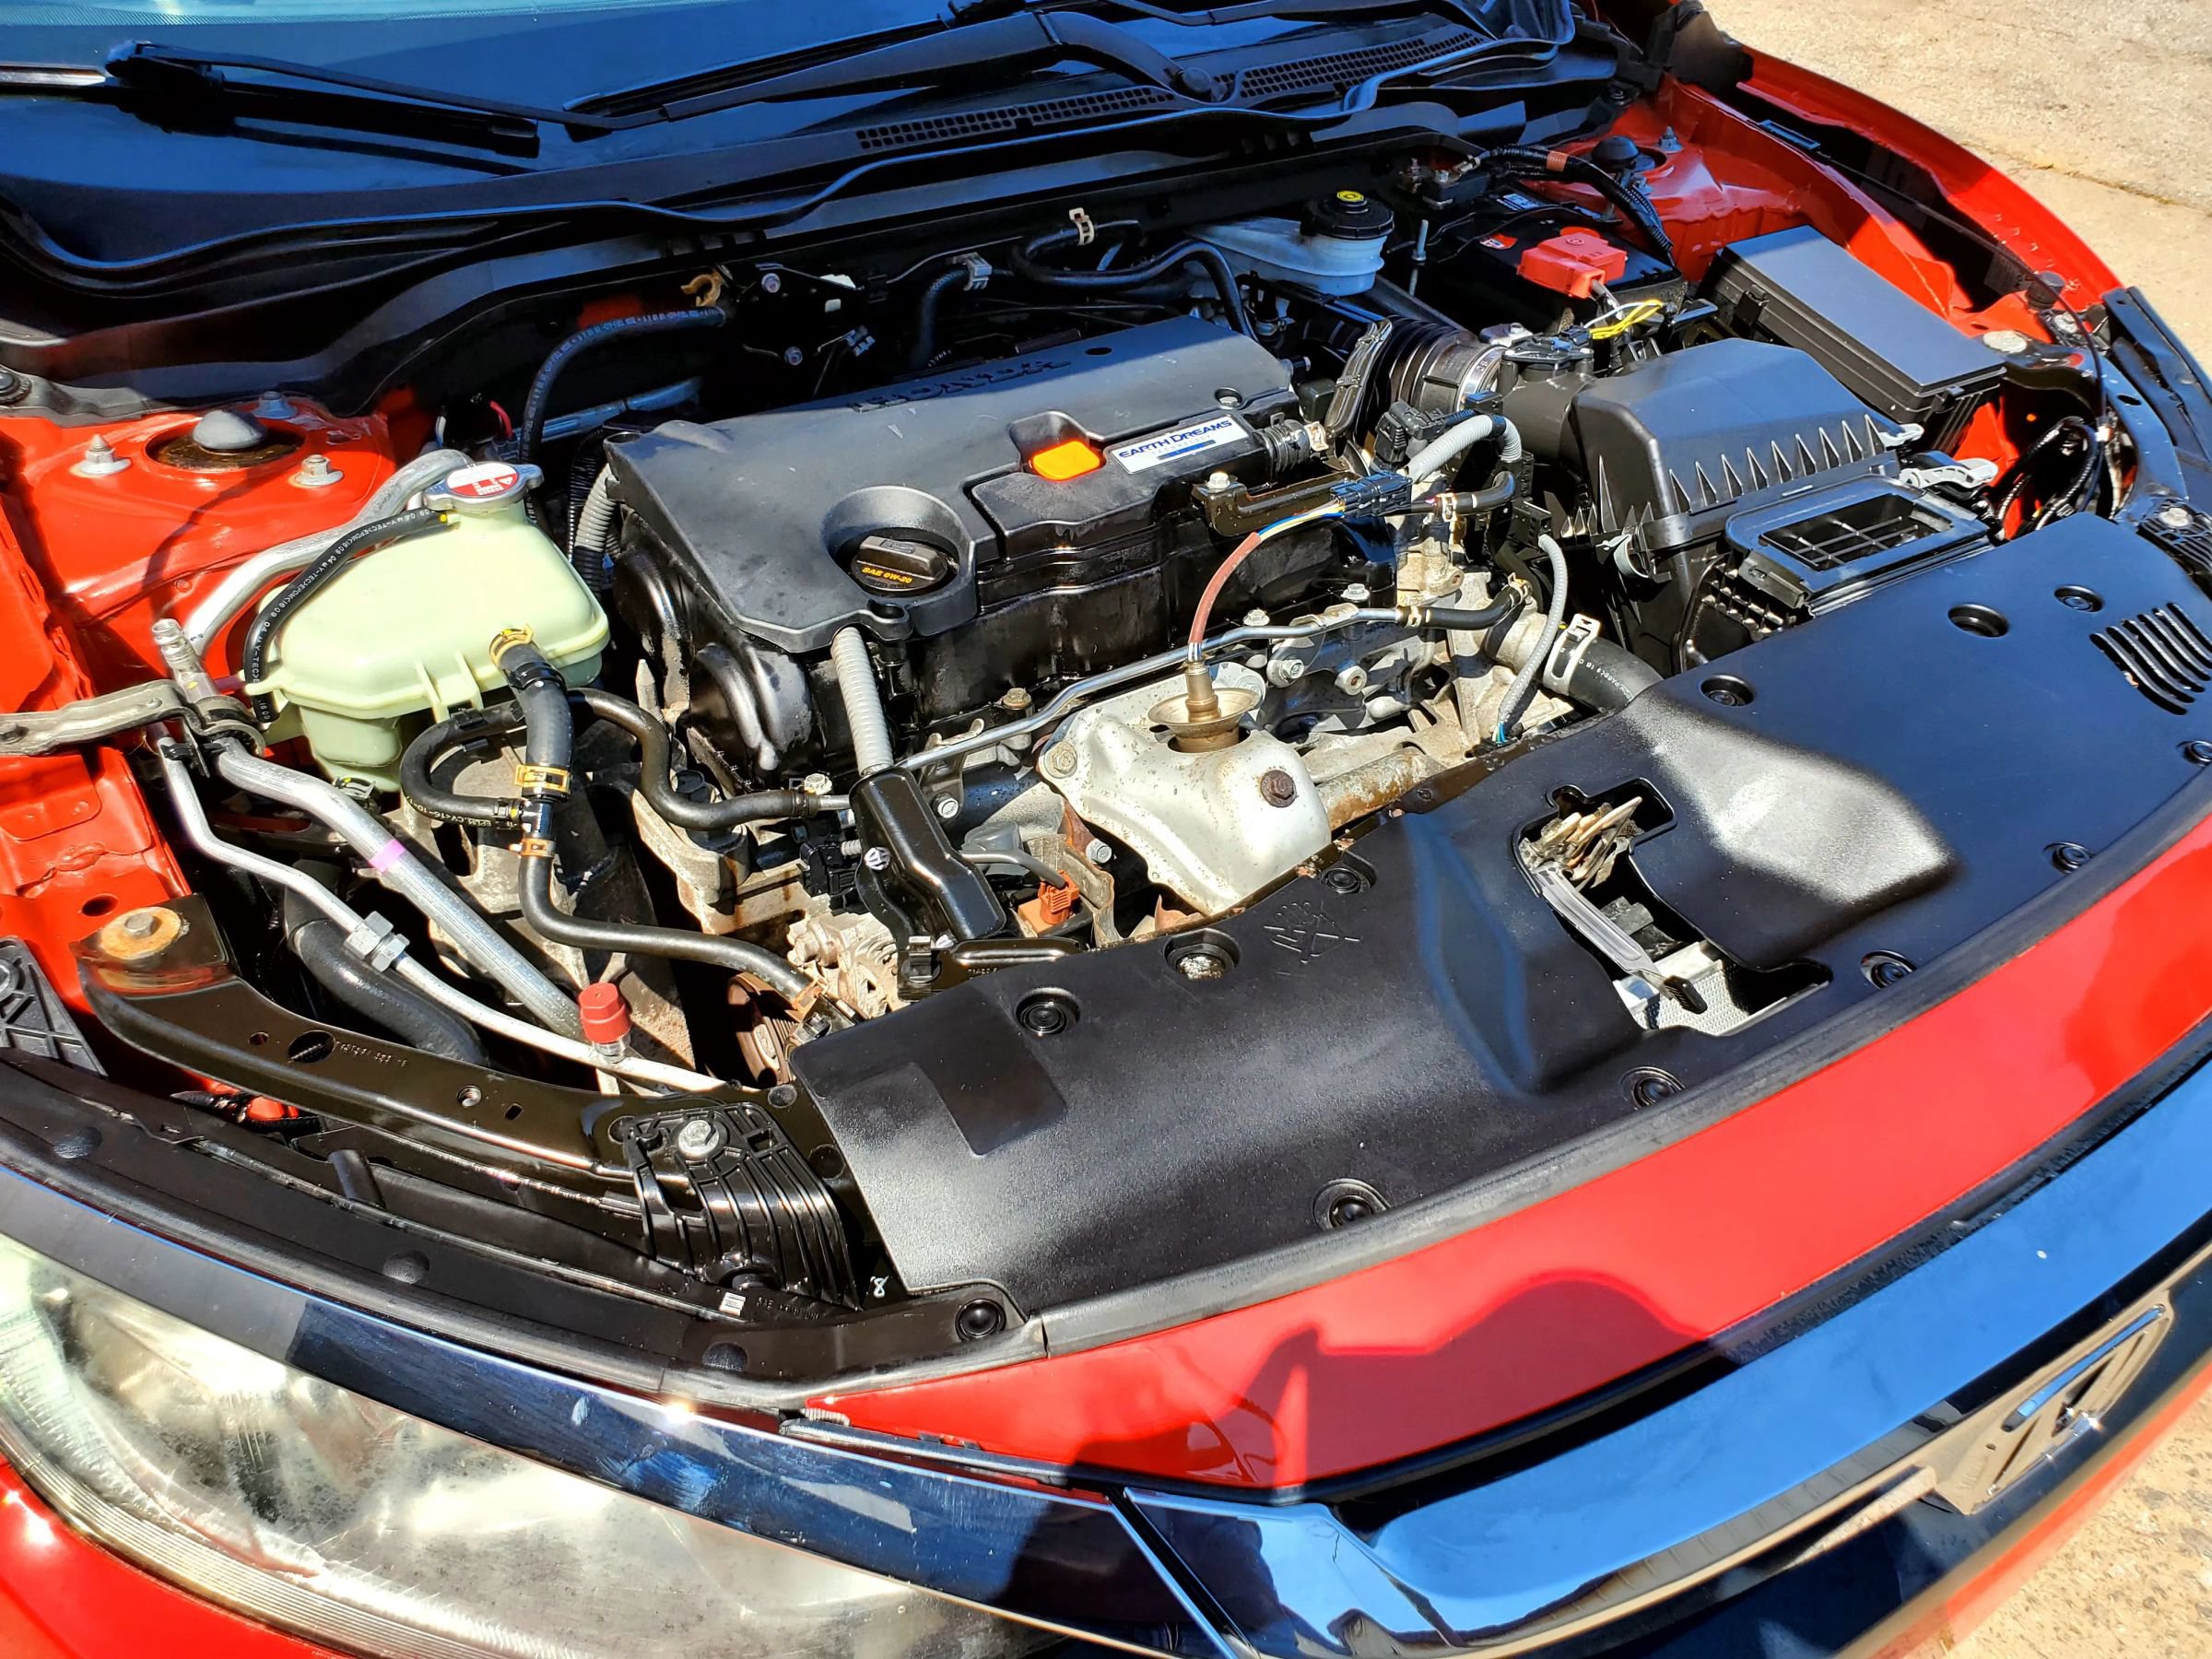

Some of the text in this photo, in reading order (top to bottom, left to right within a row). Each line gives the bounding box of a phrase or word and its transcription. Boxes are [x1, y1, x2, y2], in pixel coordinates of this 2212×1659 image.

[1119, 420, 1233, 458] EARTH DREAMS
[862, 567, 882, 577] SAE
[883, 571, 912, 583] 0W-20
